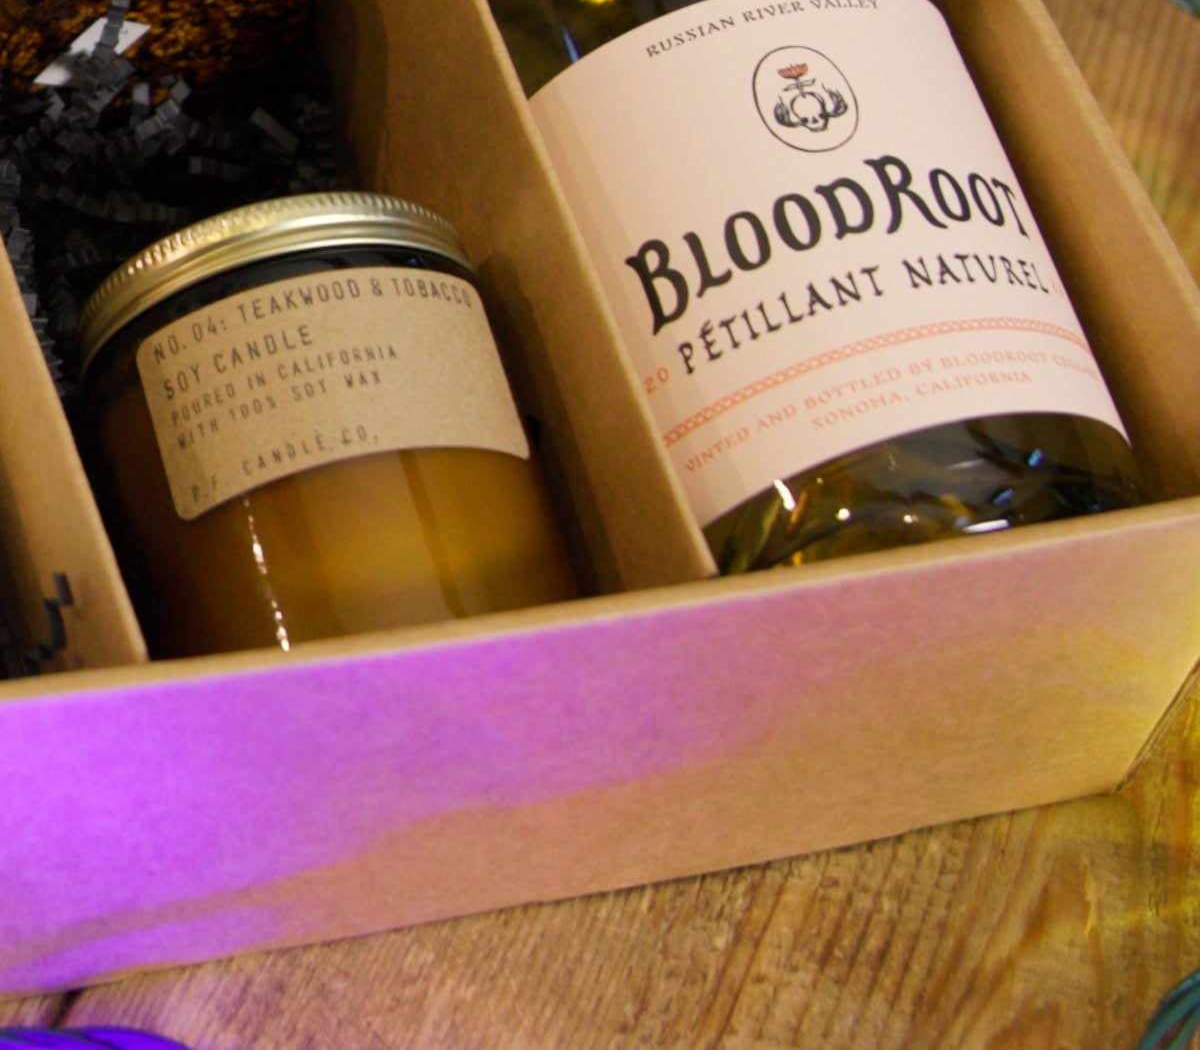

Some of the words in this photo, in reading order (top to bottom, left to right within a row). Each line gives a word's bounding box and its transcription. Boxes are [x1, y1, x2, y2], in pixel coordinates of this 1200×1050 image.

[646, 15, 735, 58] RUSSIAN
[742, 0, 805, 24] RIVER
[625, 154, 1031, 336] BLOODROOT
[153, 334, 188, 365] NO.
[191, 316, 228, 342] 04:
[237, 278, 360, 323] TEAKWOOD
[371, 278, 384, 297] &
[391, 277, 472, 308] TOBACCO
[644, 366, 669, 394] 20
[678, 265, 883, 375] PÉTILLANT
[902, 253, 1050, 294] NATUREL
[163, 364, 200, 400] SOY
[213, 324, 314, 374] CANDLE
[171, 383, 236, 426] POURED
[247, 372, 267, 390] IN
[278, 344, 399, 380] CALIFORNIA
[915, 371, 1033, 396] CALIFORNIA
[177, 417, 219, 449] WITH
[230, 395, 277, 421] 100%
[292, 378, 328, 401] SOY
[343, 369, 383, 389] WAX
[684, 427, 749, 472] VINTED
[757, 403, 797, 432] AND
[803, 366, 901, 410] BOTTLED
[908, 359, 933, 376] BY
[940, 350, 1048, 370] BLOODROOT
[242, 434, 328, 476] CANDLE
